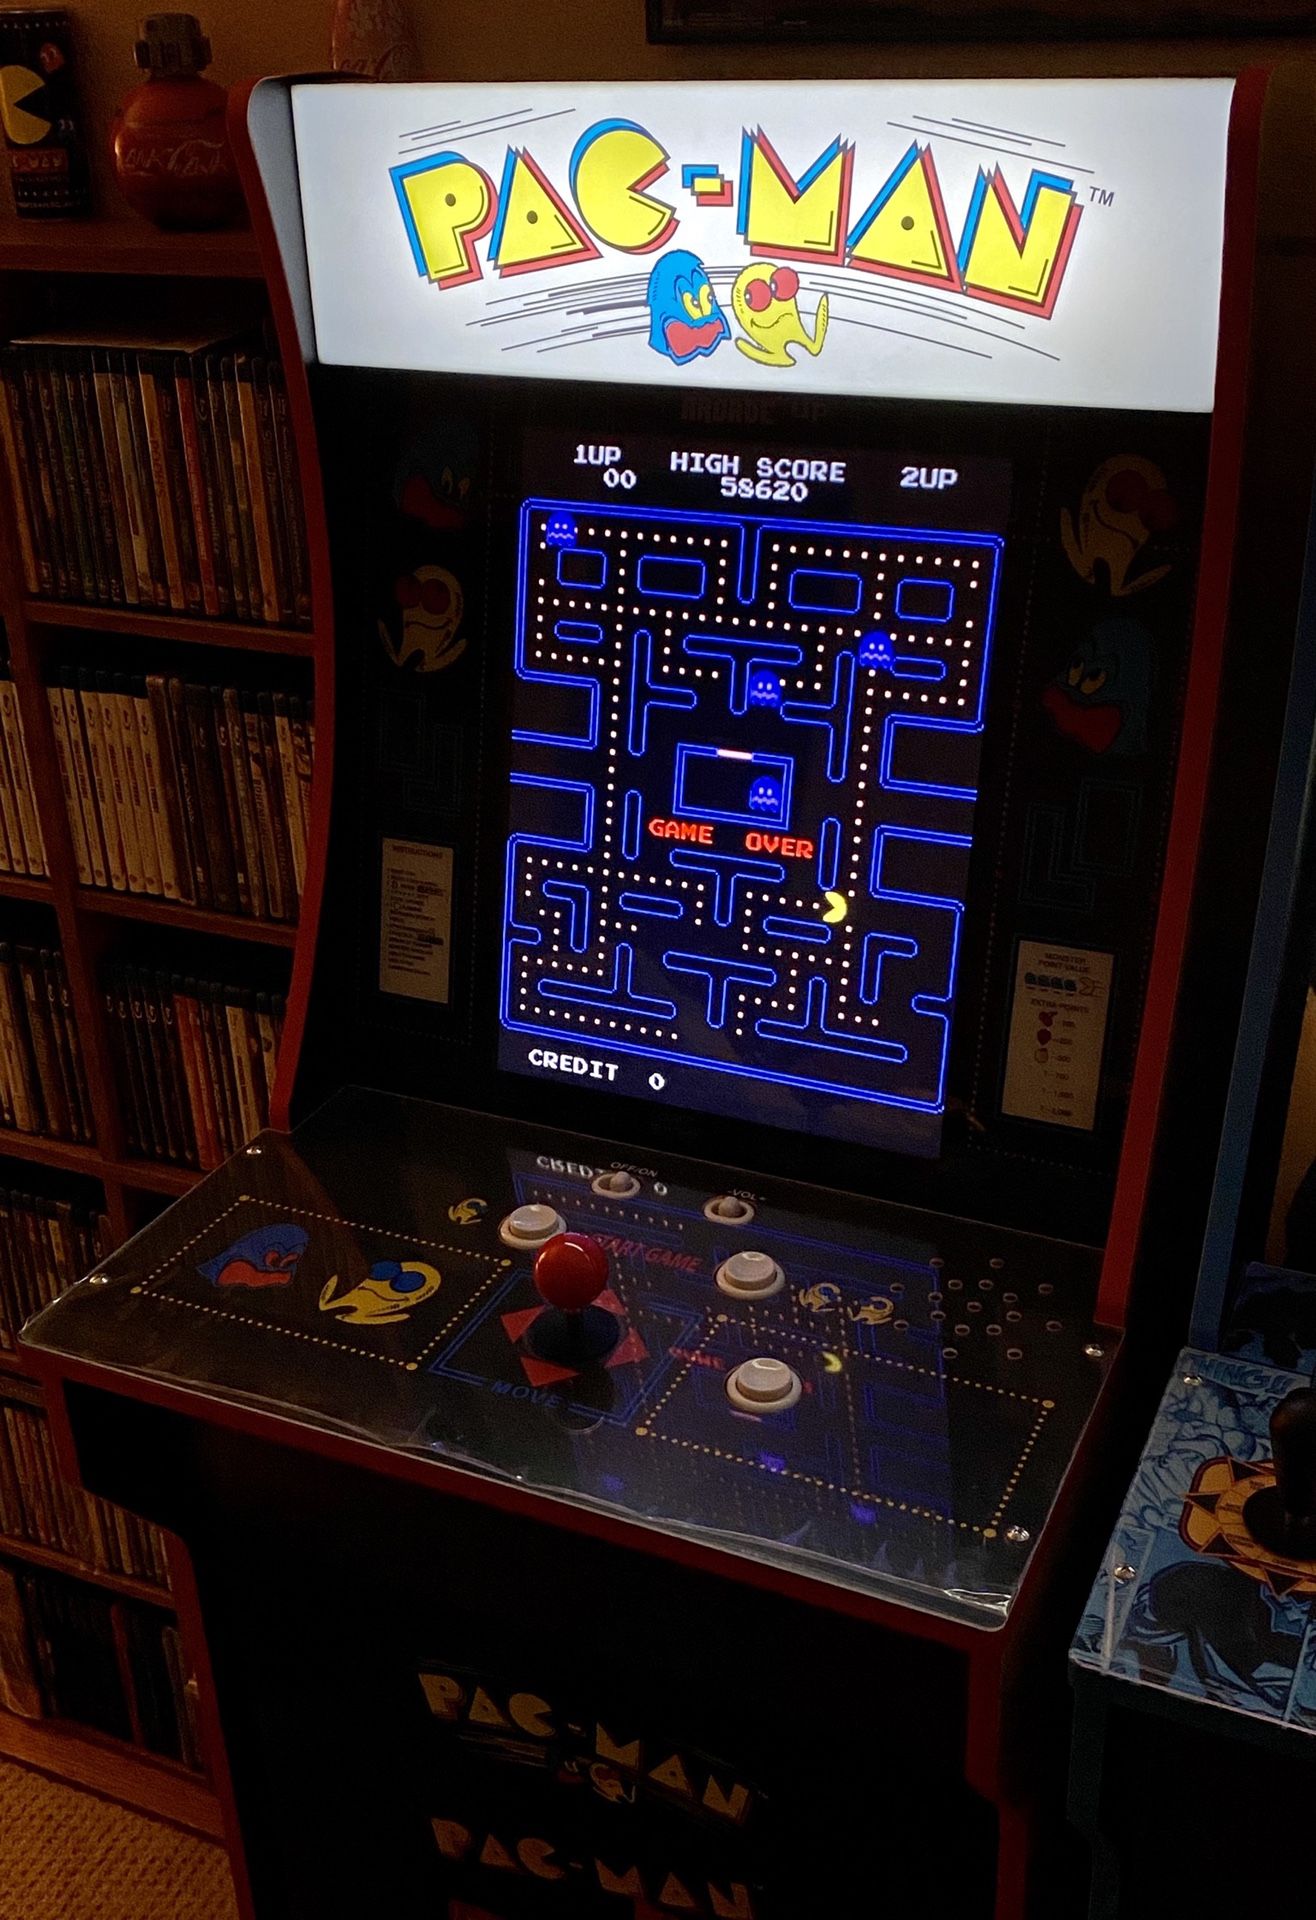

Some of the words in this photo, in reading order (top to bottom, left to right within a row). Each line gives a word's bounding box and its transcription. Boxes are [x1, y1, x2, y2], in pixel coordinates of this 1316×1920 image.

[1089, 185, 1115, 207] TM
[389, 117, 1085, 320] PAC-MAN
[573, 444, 622, 466] 1UP
[670, 451, 739, 476] HIGH
[756, 457, 846, 484] SCORE
[603, 468, 637, 489] 00
[720, 476, 808, 502] 58620
[900, 466, 958, 490] 2UP
[648, 818, 714, 844] GAME
[745, 832, 813, 859] OVER
[528, 1048, 619, 1081] CREDIT
[648, 1072, 665, 1090] 0
[609, 1160, 659, 1178] OFF/ON
[646, 1247, 703, 1274] GAME
[490, 1380, 560, 1409] MOVE
[415, 1670, 753, 1829] PAC-MAN
